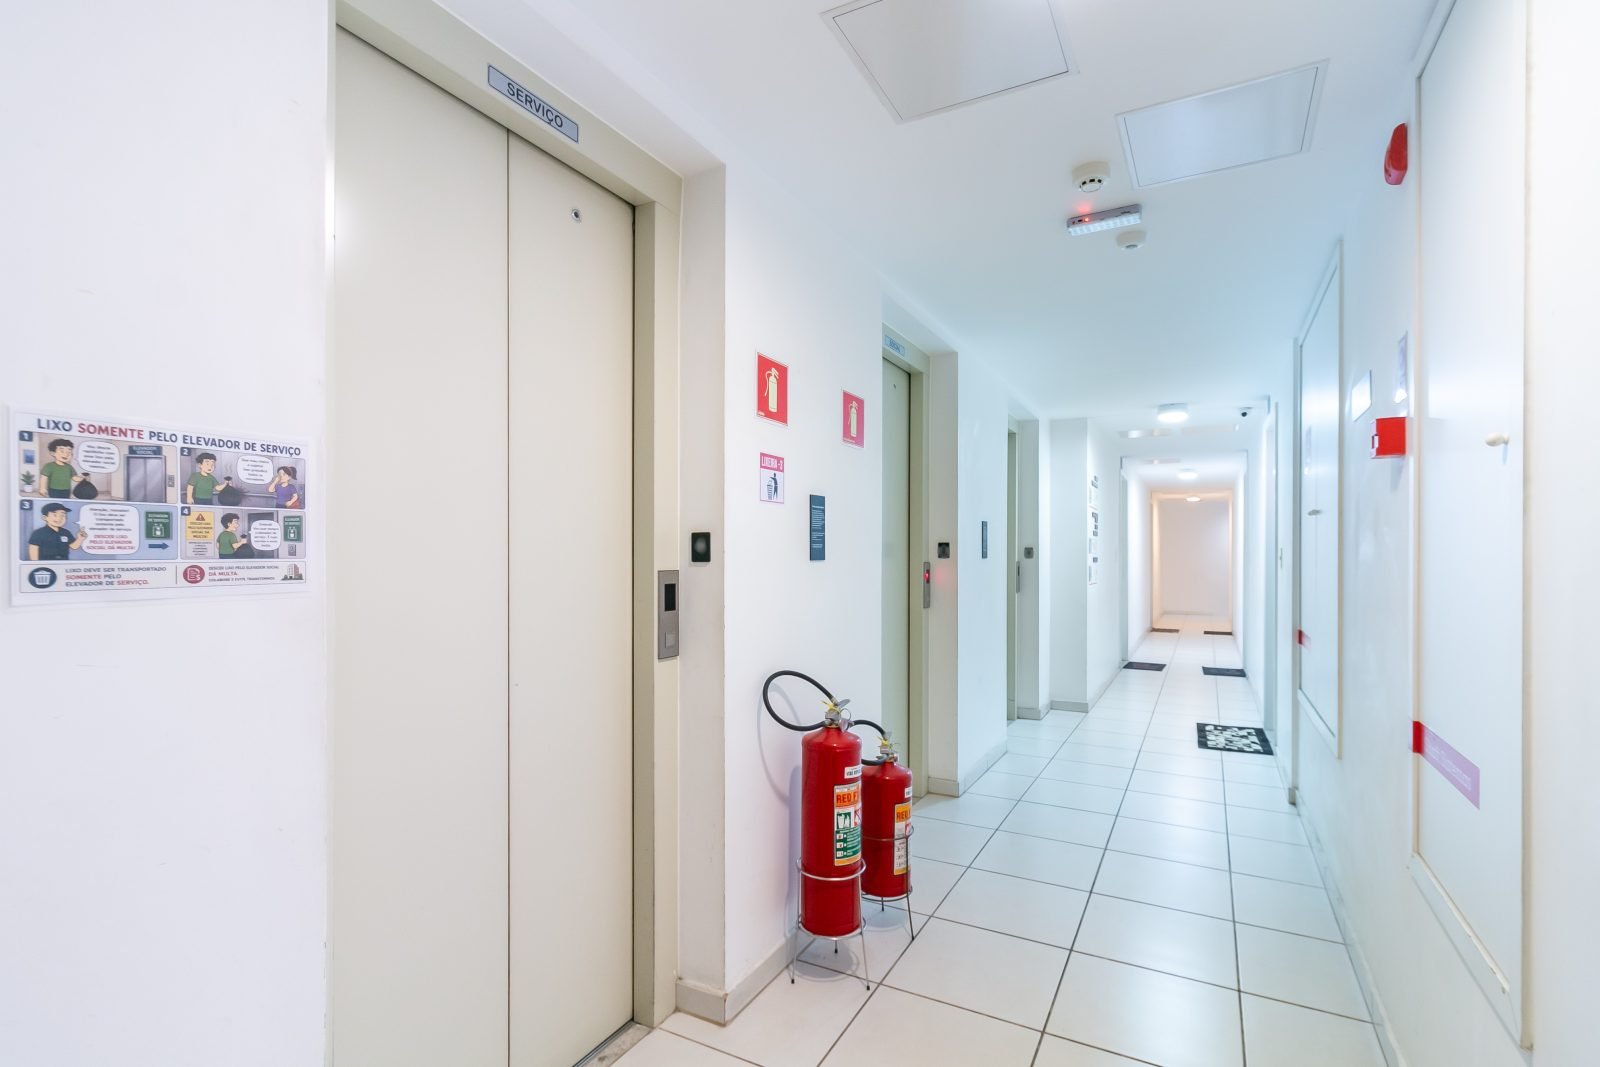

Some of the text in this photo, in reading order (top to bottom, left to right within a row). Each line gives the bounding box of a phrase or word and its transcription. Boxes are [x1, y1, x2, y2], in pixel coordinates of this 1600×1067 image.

[507, 82, 563, 127] SERVIÇO
[37, 418, 301, 456] LIXO SOMENTE PELO ELEVADOR DE SERVIÇO
[23, 501, 30, 509] 3
[836, 793, 851, 804] RED
